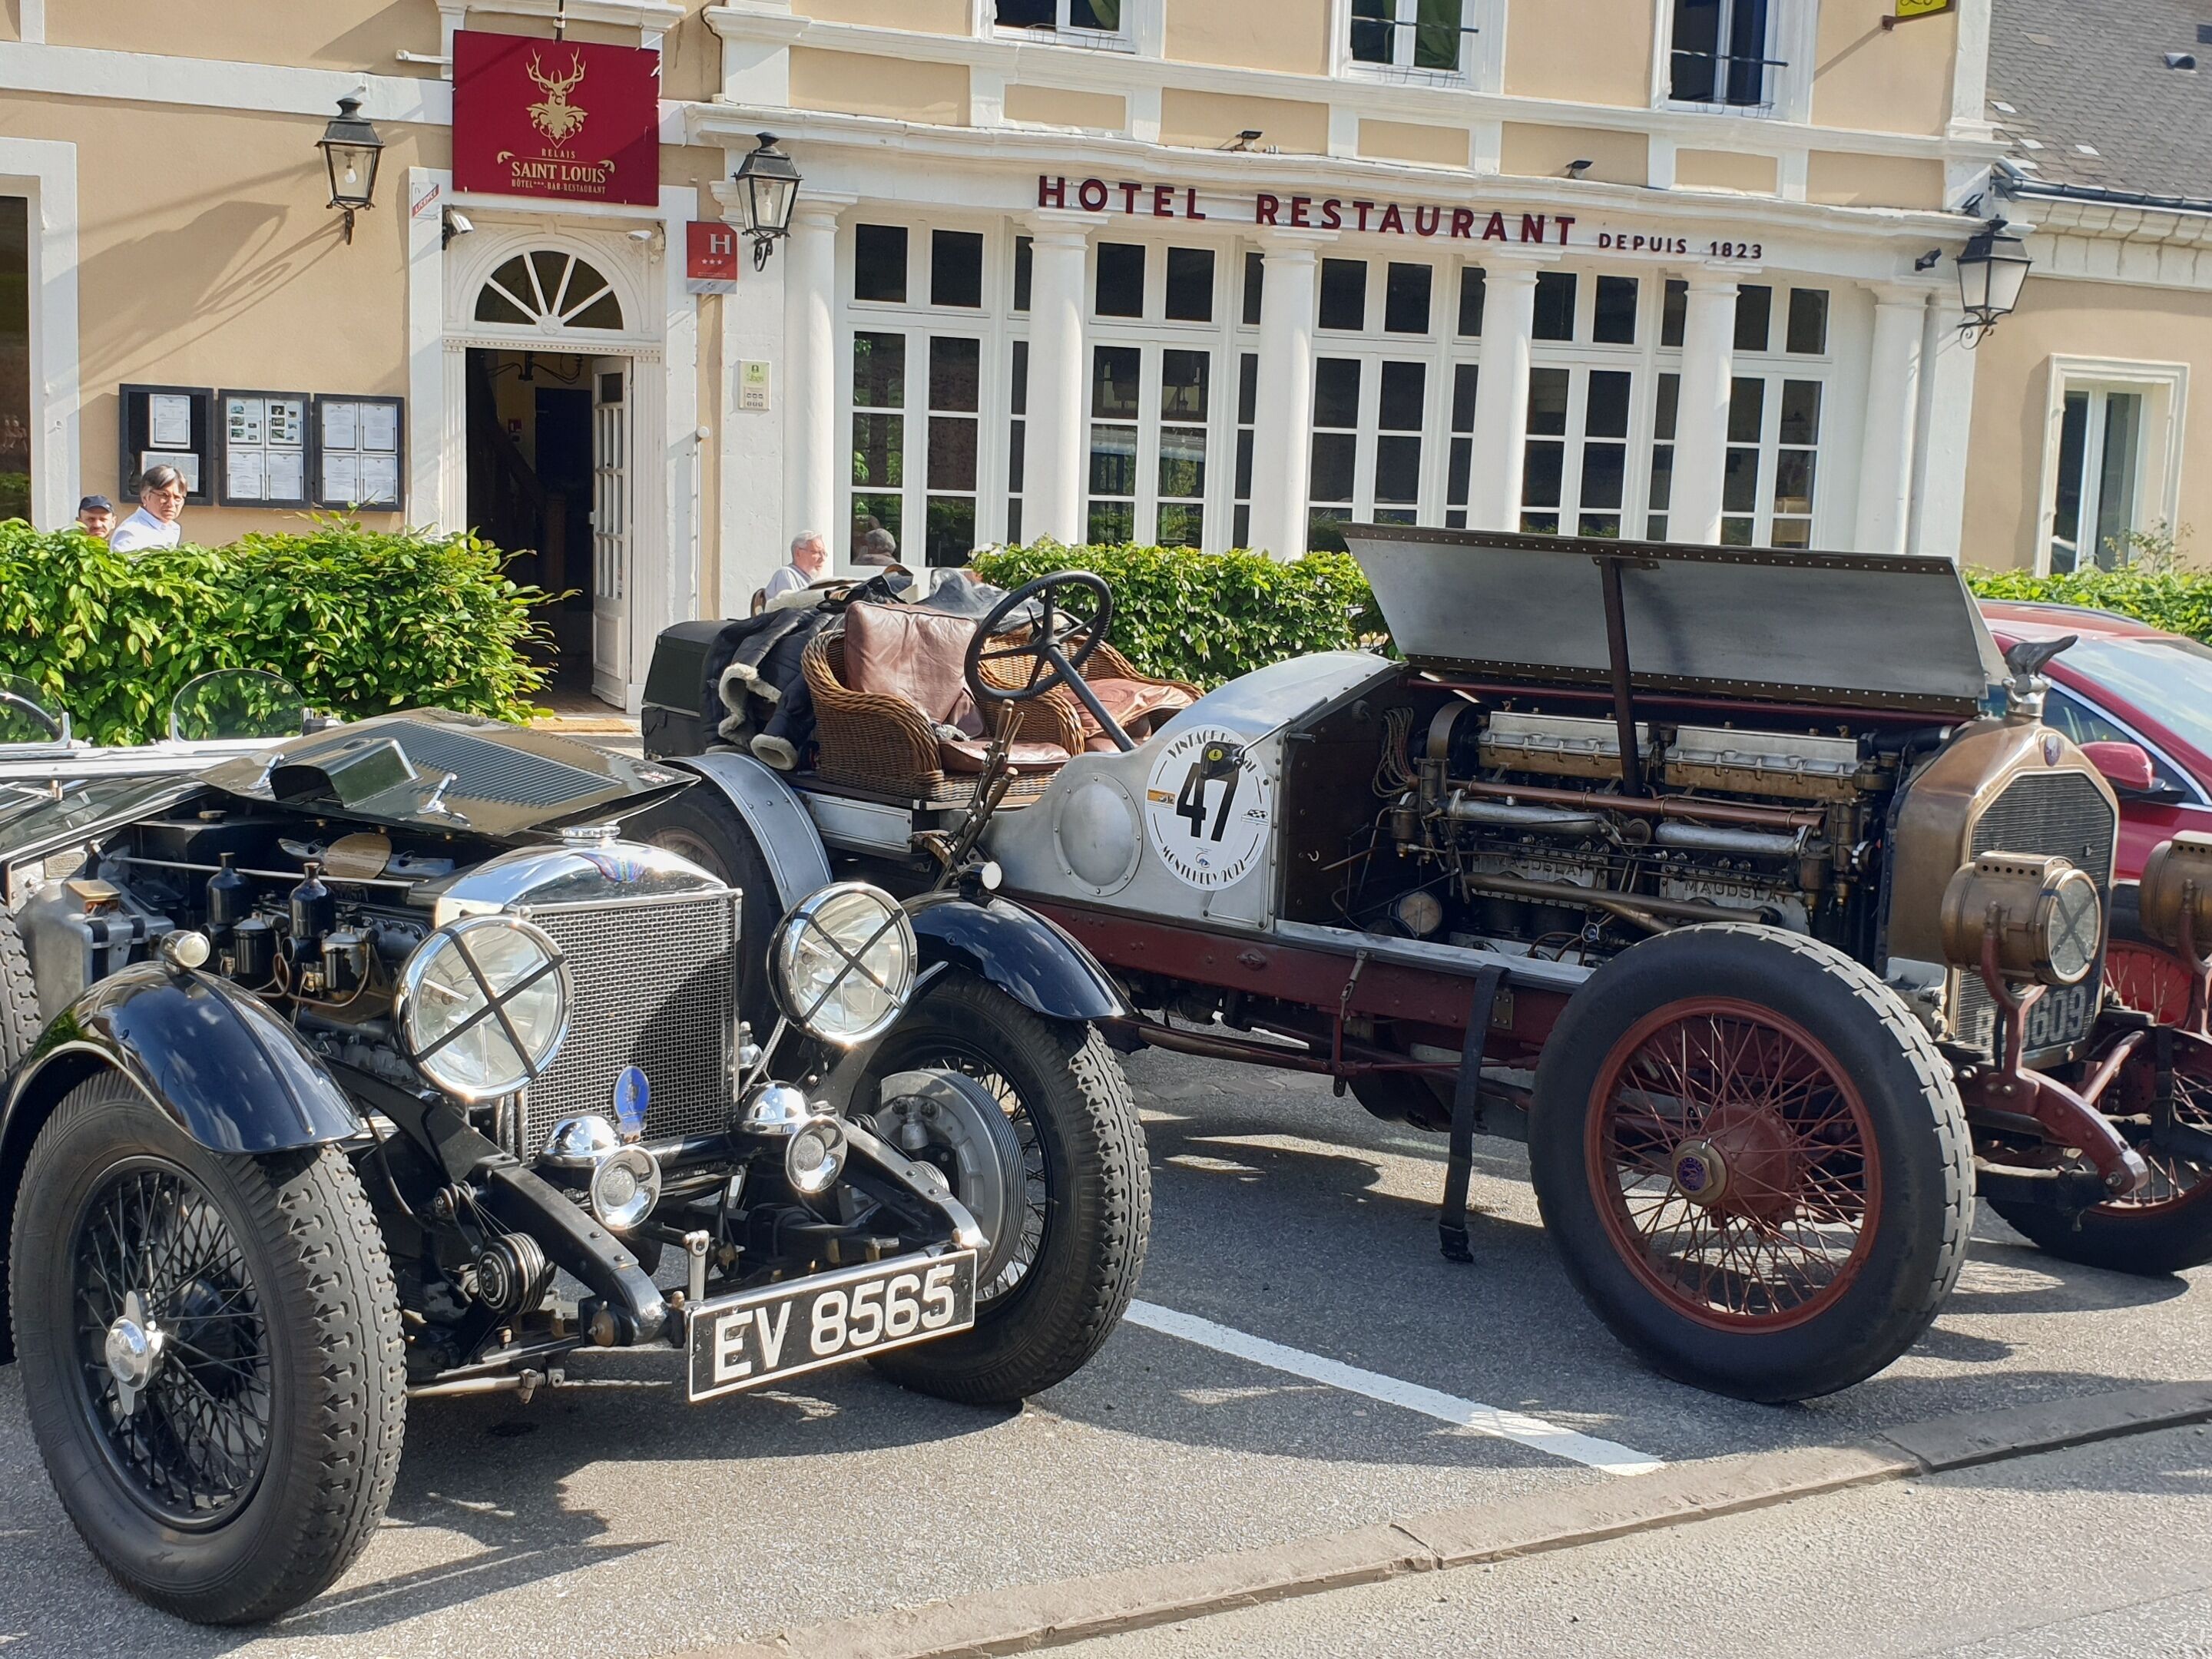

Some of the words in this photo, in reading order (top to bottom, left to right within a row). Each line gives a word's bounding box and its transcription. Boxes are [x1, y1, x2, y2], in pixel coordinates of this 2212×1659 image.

[541, 148, 575, 159] RELAIS
[512, 161, 558, 180] SAINT
[561, 165, 606, 184] LOUIS
[1038, 175, 1206, 220] HOTEL
[1256, 194, 1575, 246] RESTAURANT
[710, 233, 730, 254] H
[1598, 233, 1687, 254] DEPUIS
[1710, 241, 1763, 259] 1823
[1167, 730, 1217, 759] VINTAGE
[1176, 762, 1240, 842] 47
[1221, 859, 1246, 882] 2022
[714, 1301, 792, 1383] EV
[810, 1264, 955, 1356] 8565
